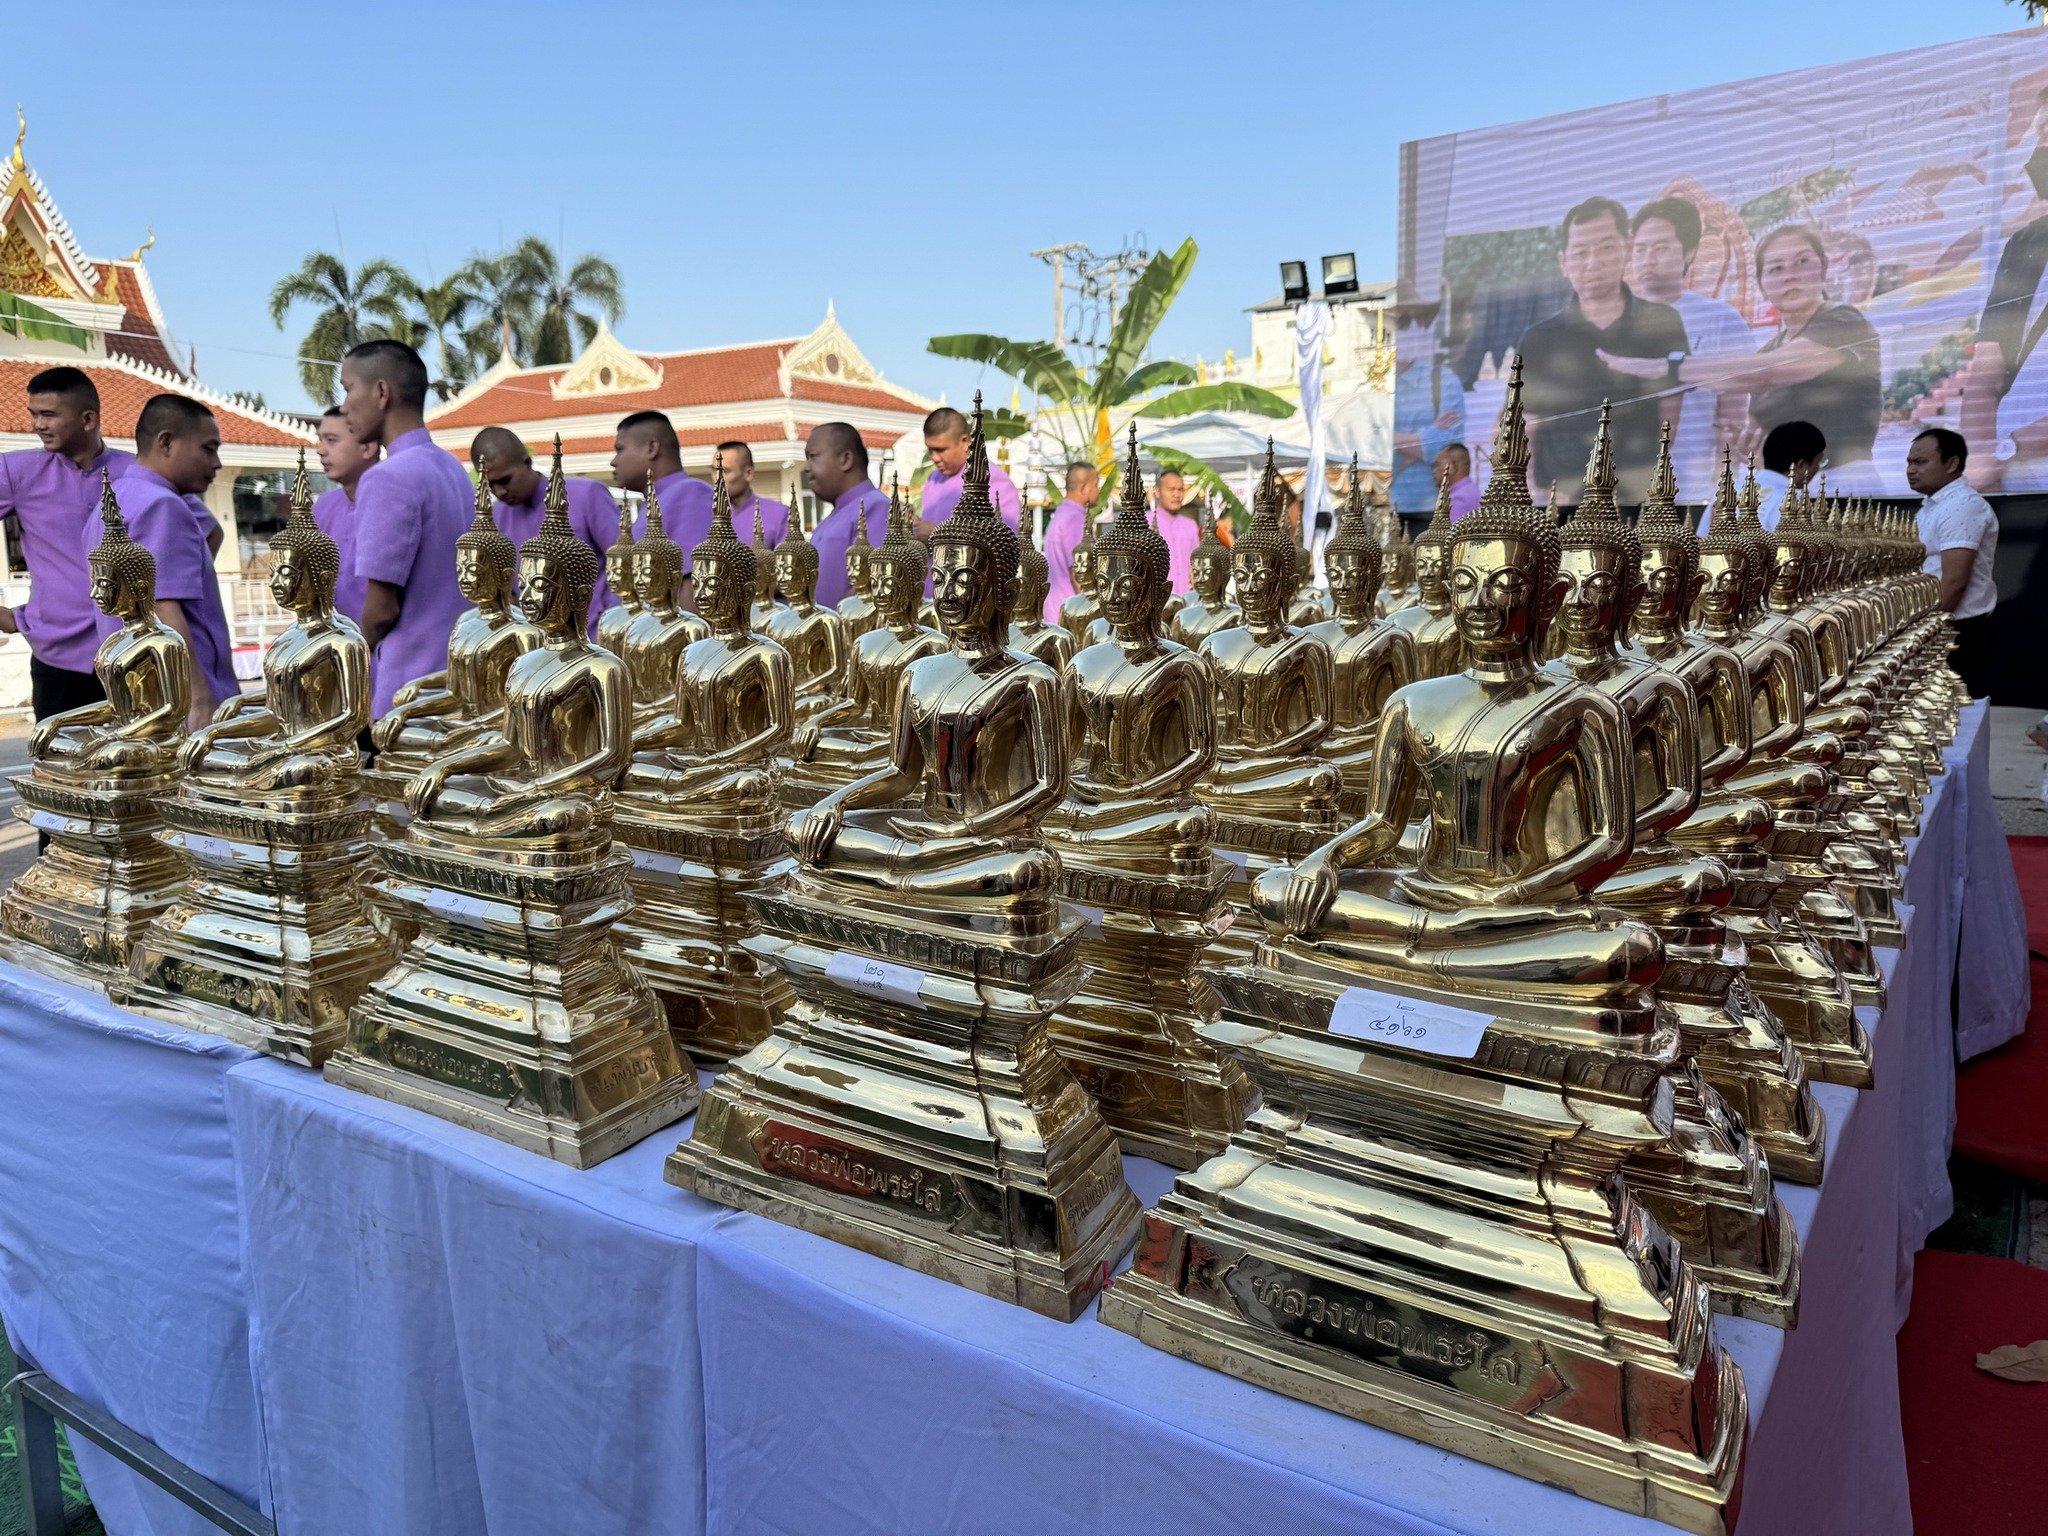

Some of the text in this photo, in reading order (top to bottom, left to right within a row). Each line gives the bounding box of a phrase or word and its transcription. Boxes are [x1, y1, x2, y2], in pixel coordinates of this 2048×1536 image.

[770, 1137, 943, 1213] หลวงพ่อพระใส
[1252, 1275, 1521, 1387] หลวงพ่อพระใส
